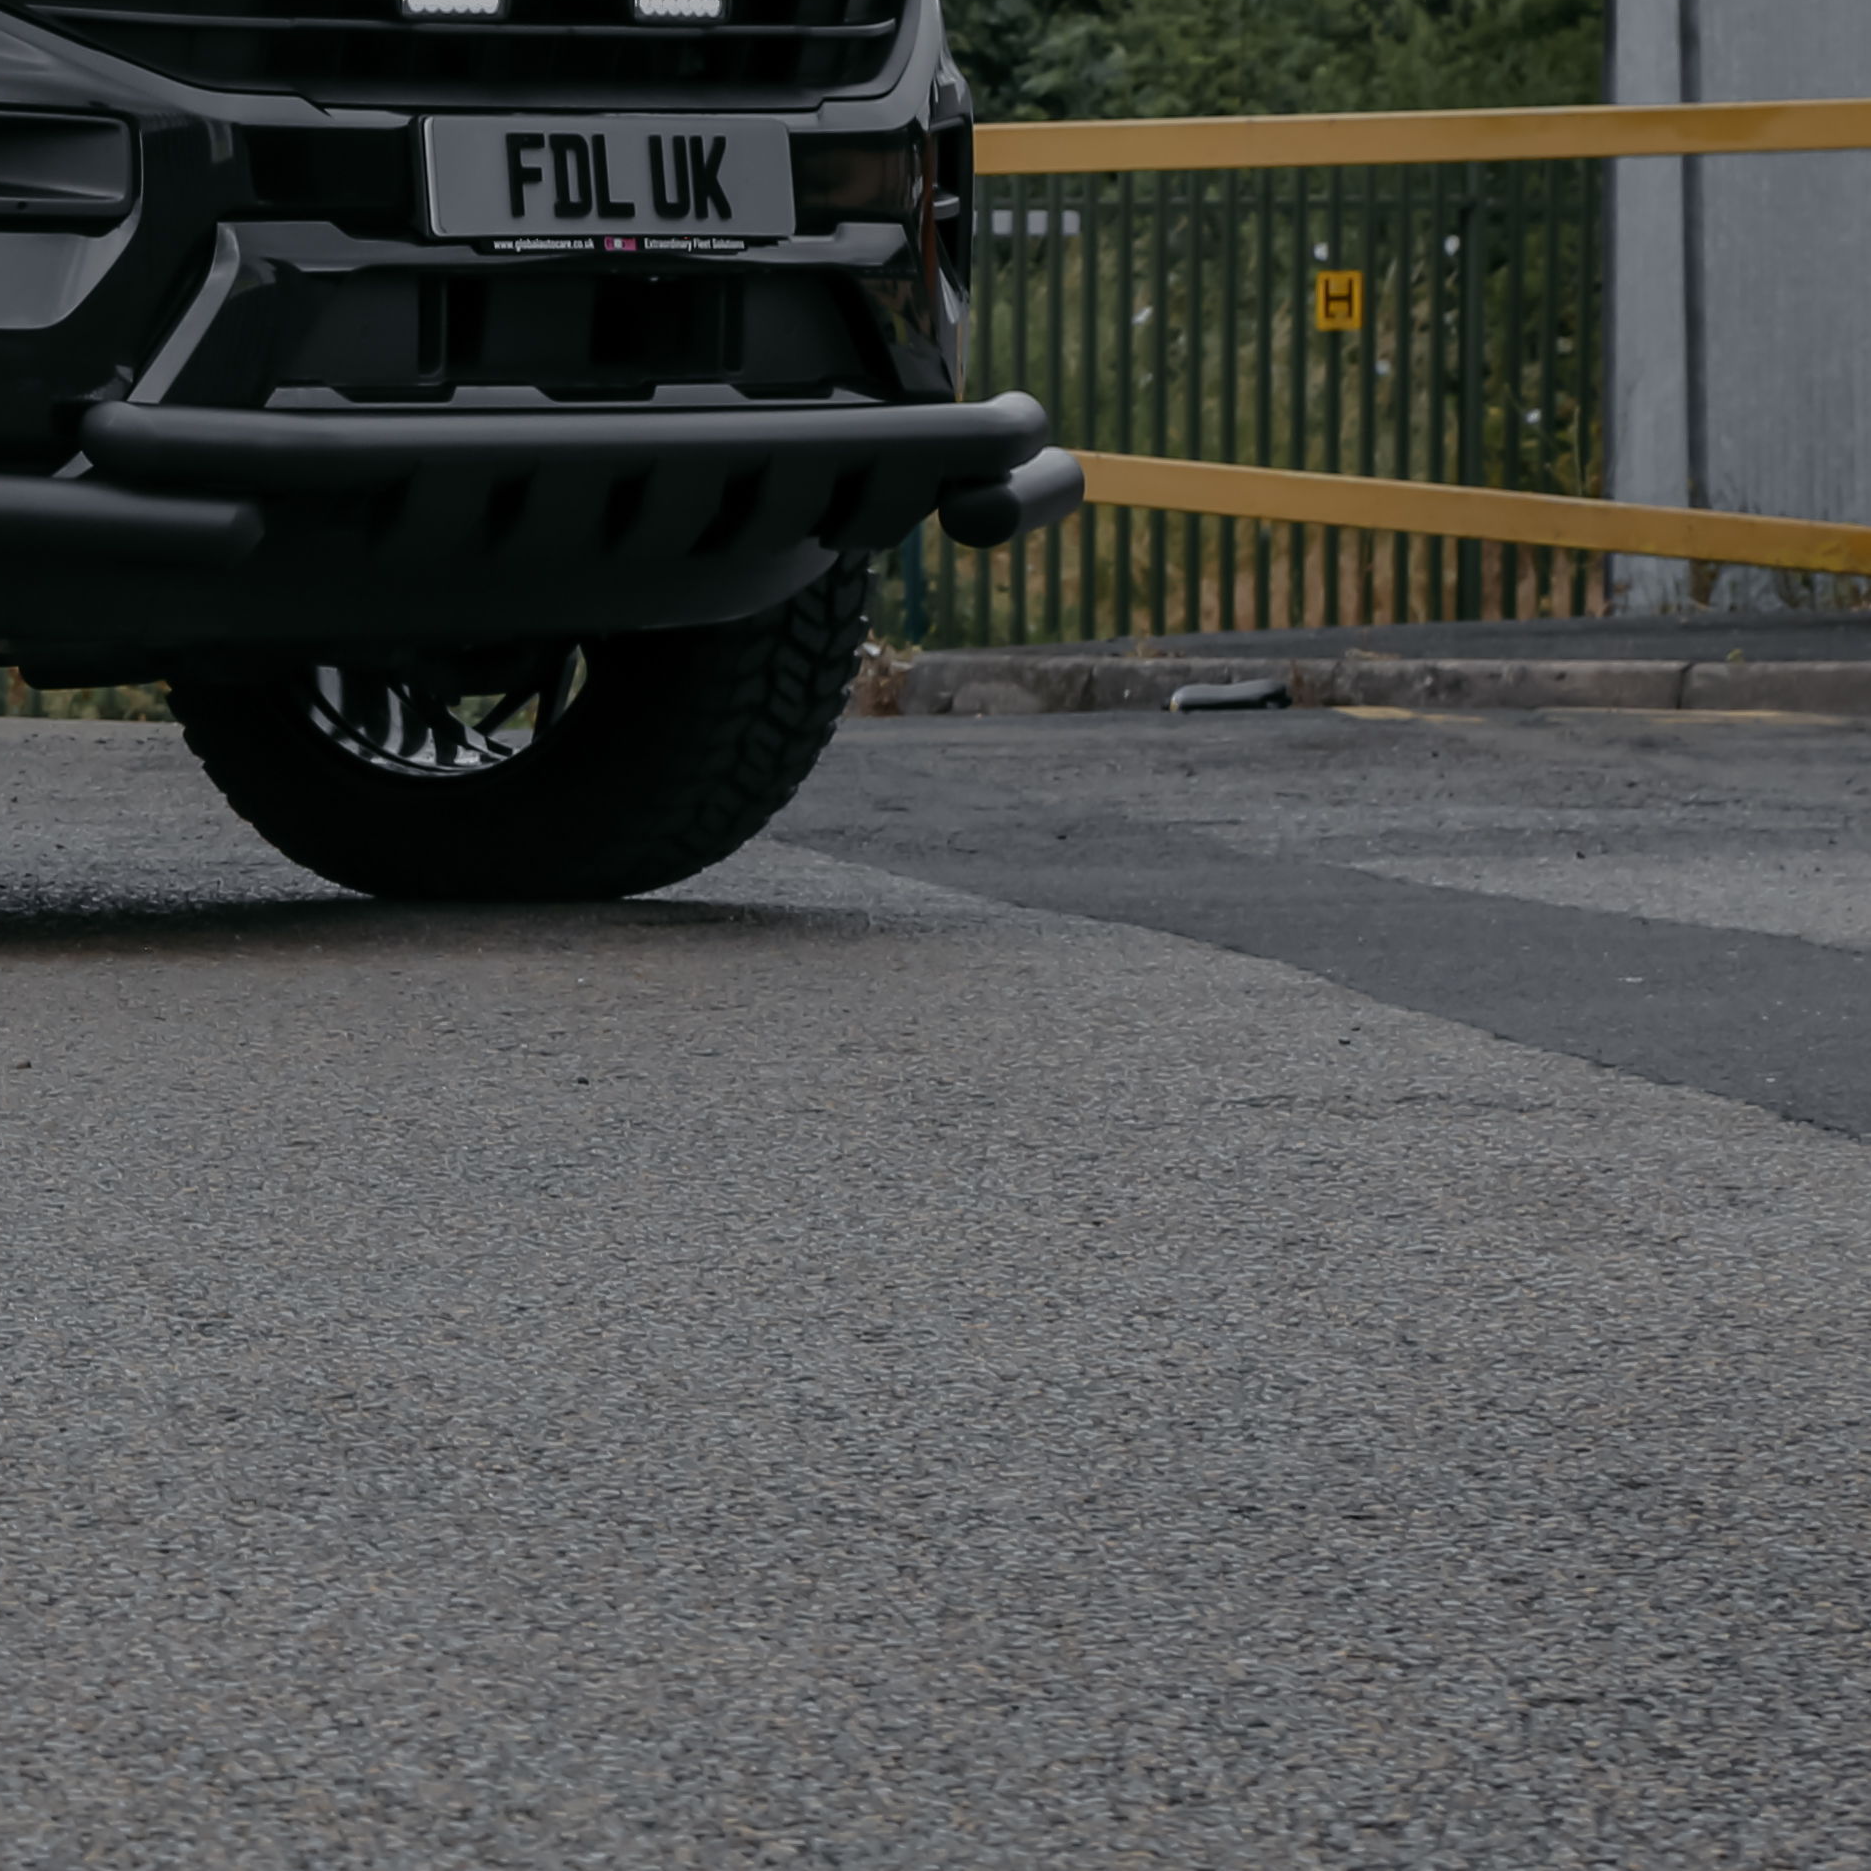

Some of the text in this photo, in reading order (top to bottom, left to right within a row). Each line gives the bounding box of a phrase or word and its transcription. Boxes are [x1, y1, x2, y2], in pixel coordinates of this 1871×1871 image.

[505, 133, 732, 220] FDL UK
[1324, 277, 1353, 319] H
